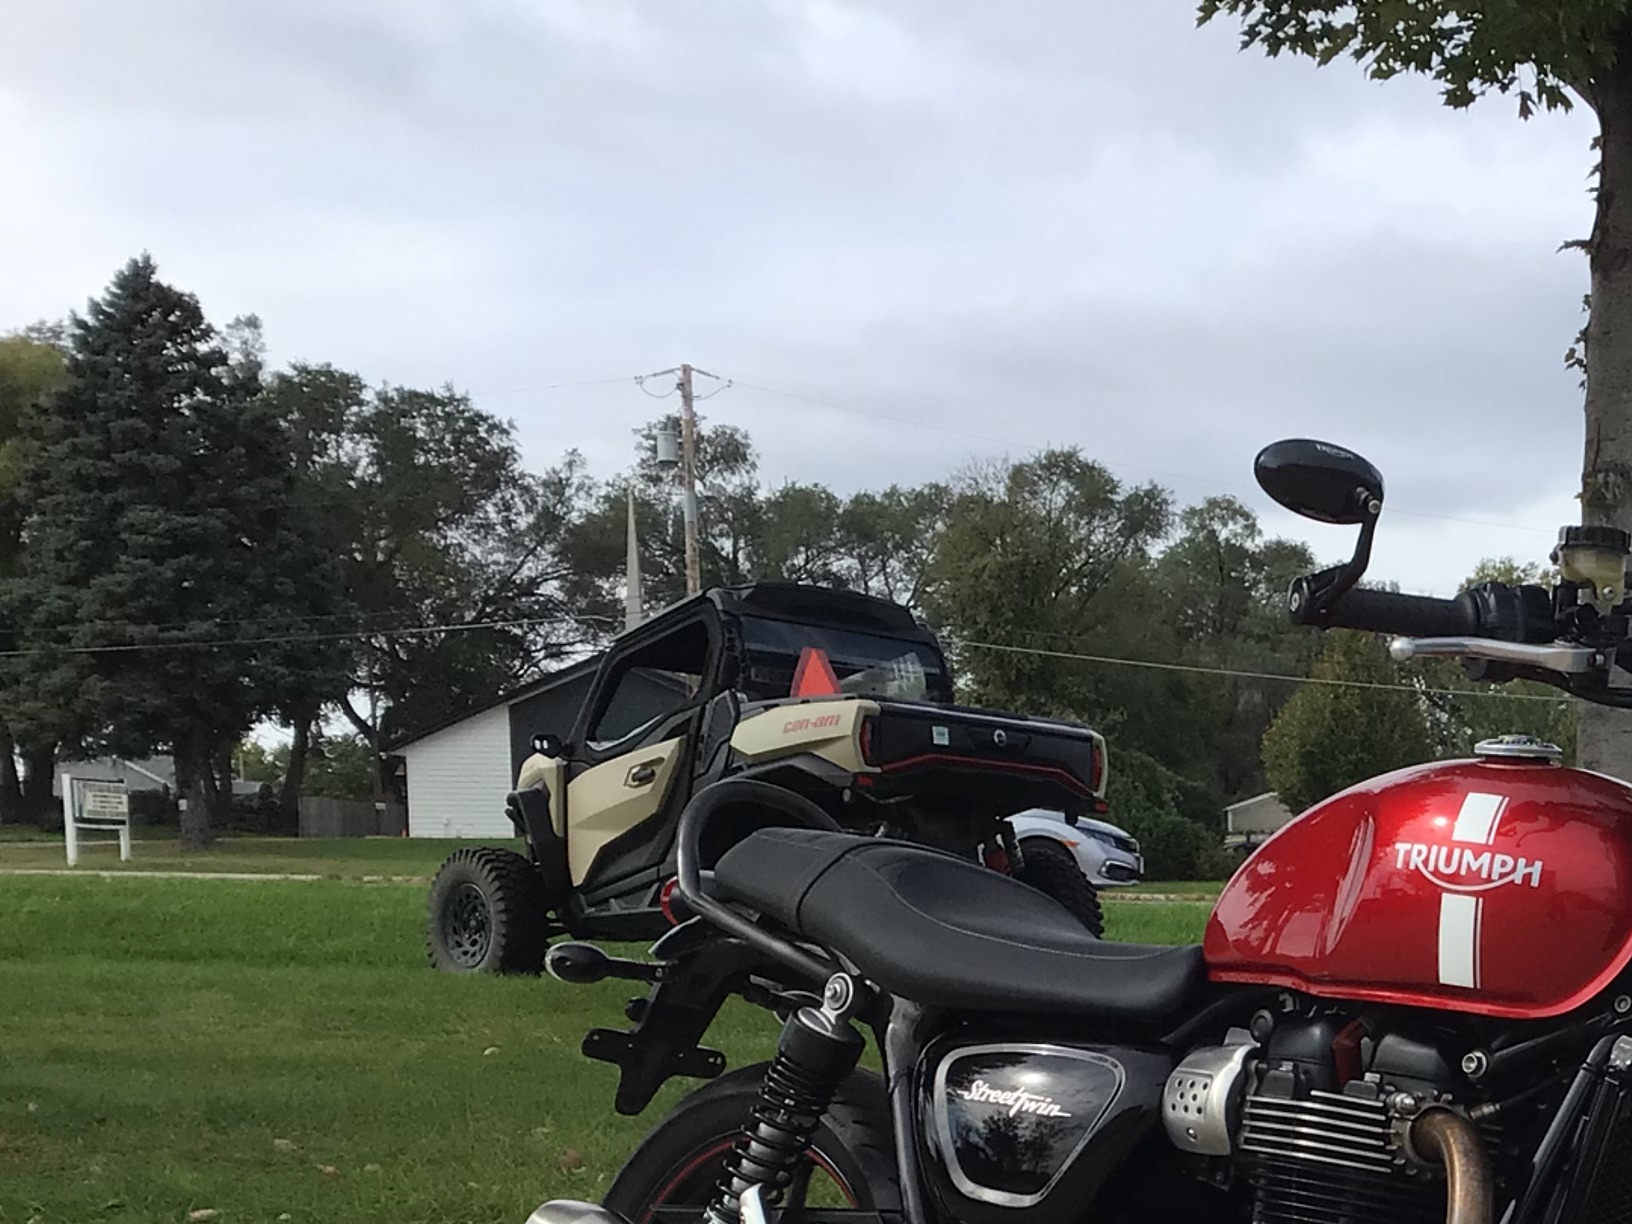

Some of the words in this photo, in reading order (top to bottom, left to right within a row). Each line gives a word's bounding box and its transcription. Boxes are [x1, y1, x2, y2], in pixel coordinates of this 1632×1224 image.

[1395, 842, 1543, 891] TRIUMPH
[957, 1080, 1025, 1106] Street
[1008, 1092, 1071, 1117] Twin
